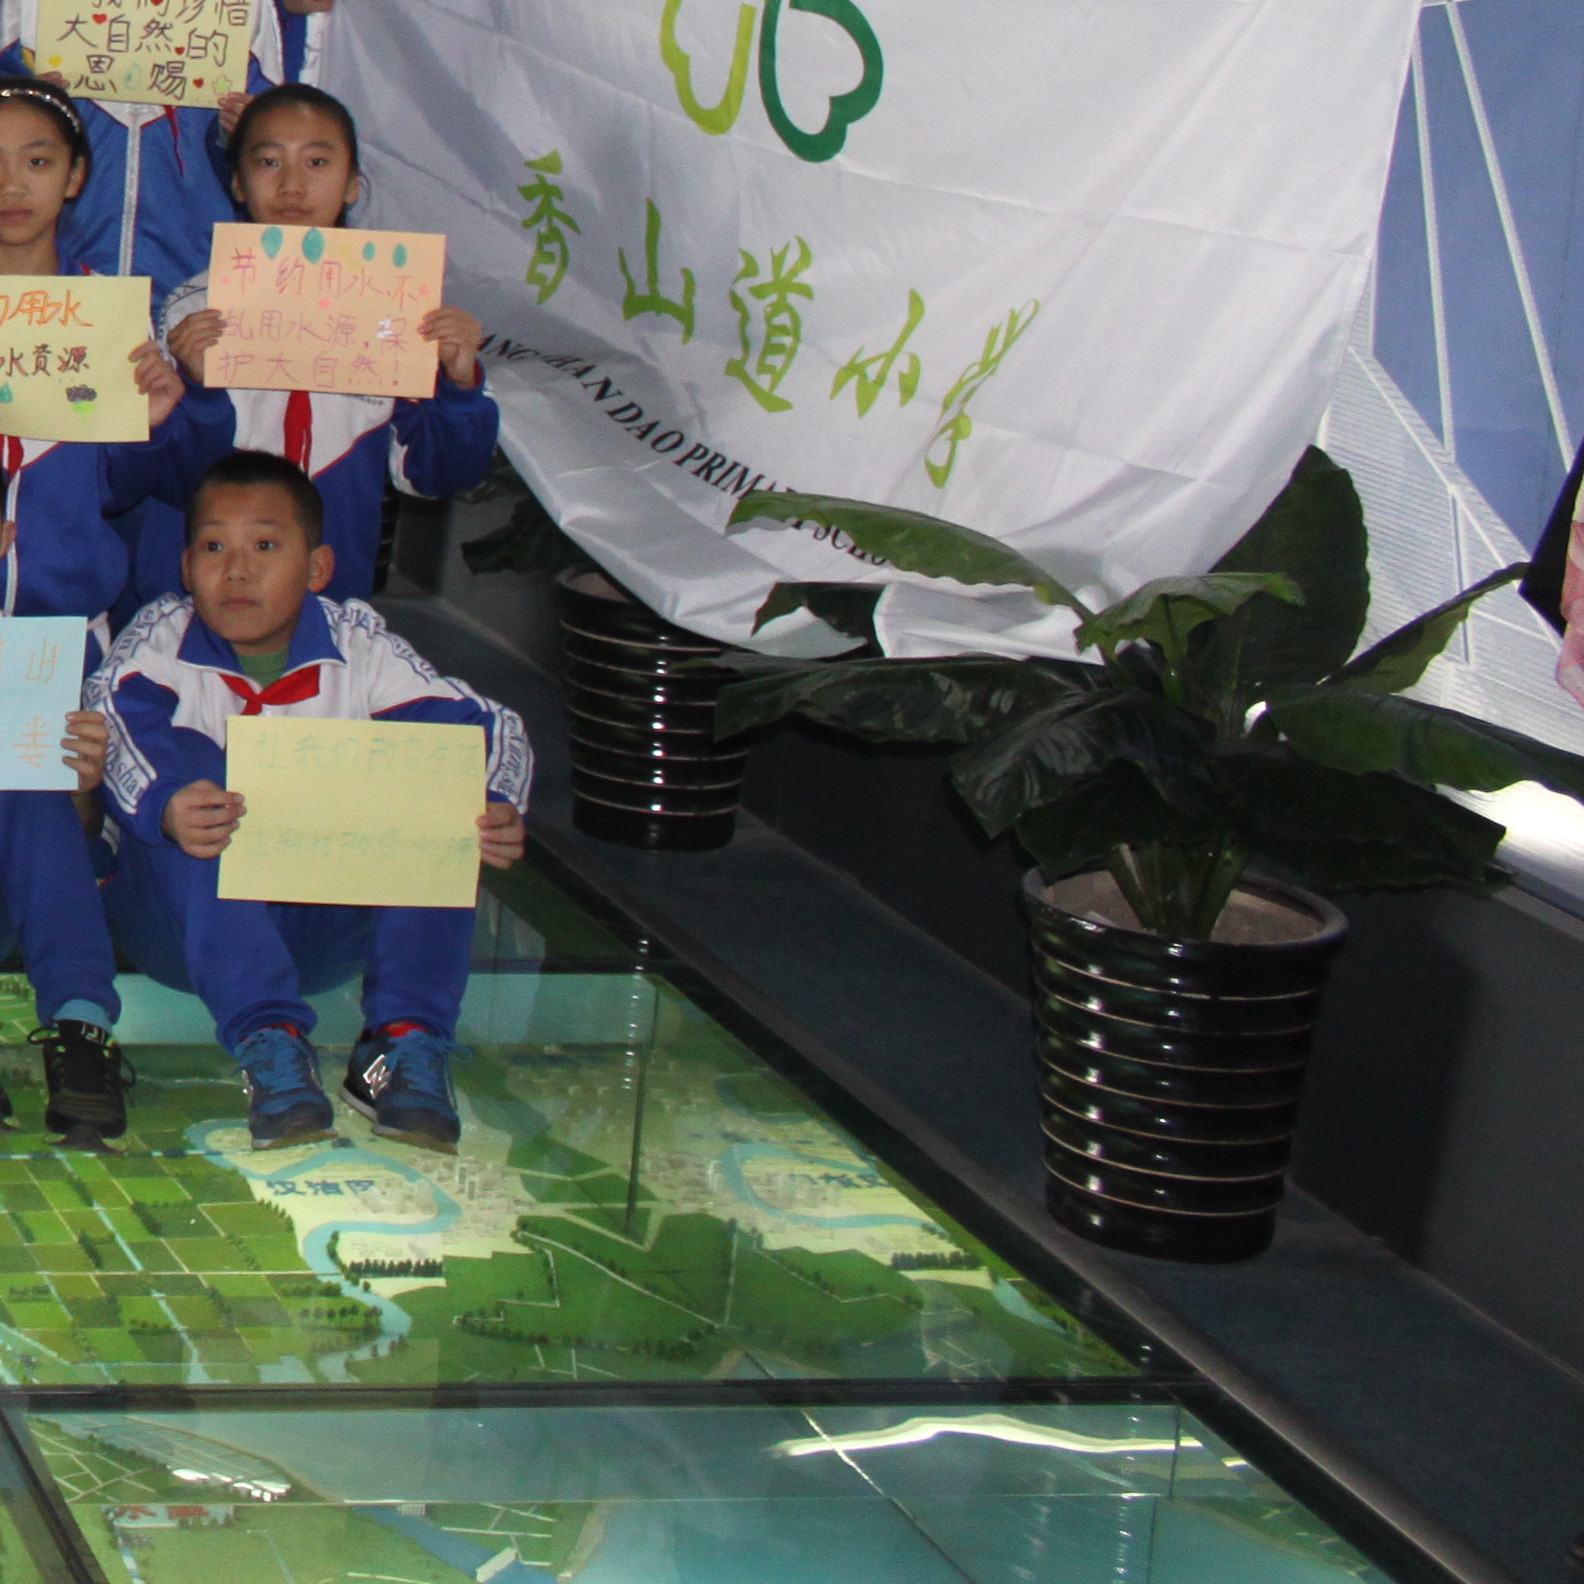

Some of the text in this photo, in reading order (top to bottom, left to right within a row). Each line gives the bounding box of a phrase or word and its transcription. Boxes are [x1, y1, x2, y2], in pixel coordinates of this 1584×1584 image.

[56, 13, 229, 67] 大自然的
[73, 53, 189, 101] 恩赐
[516, 148, 1041, 488] 香山道小学
